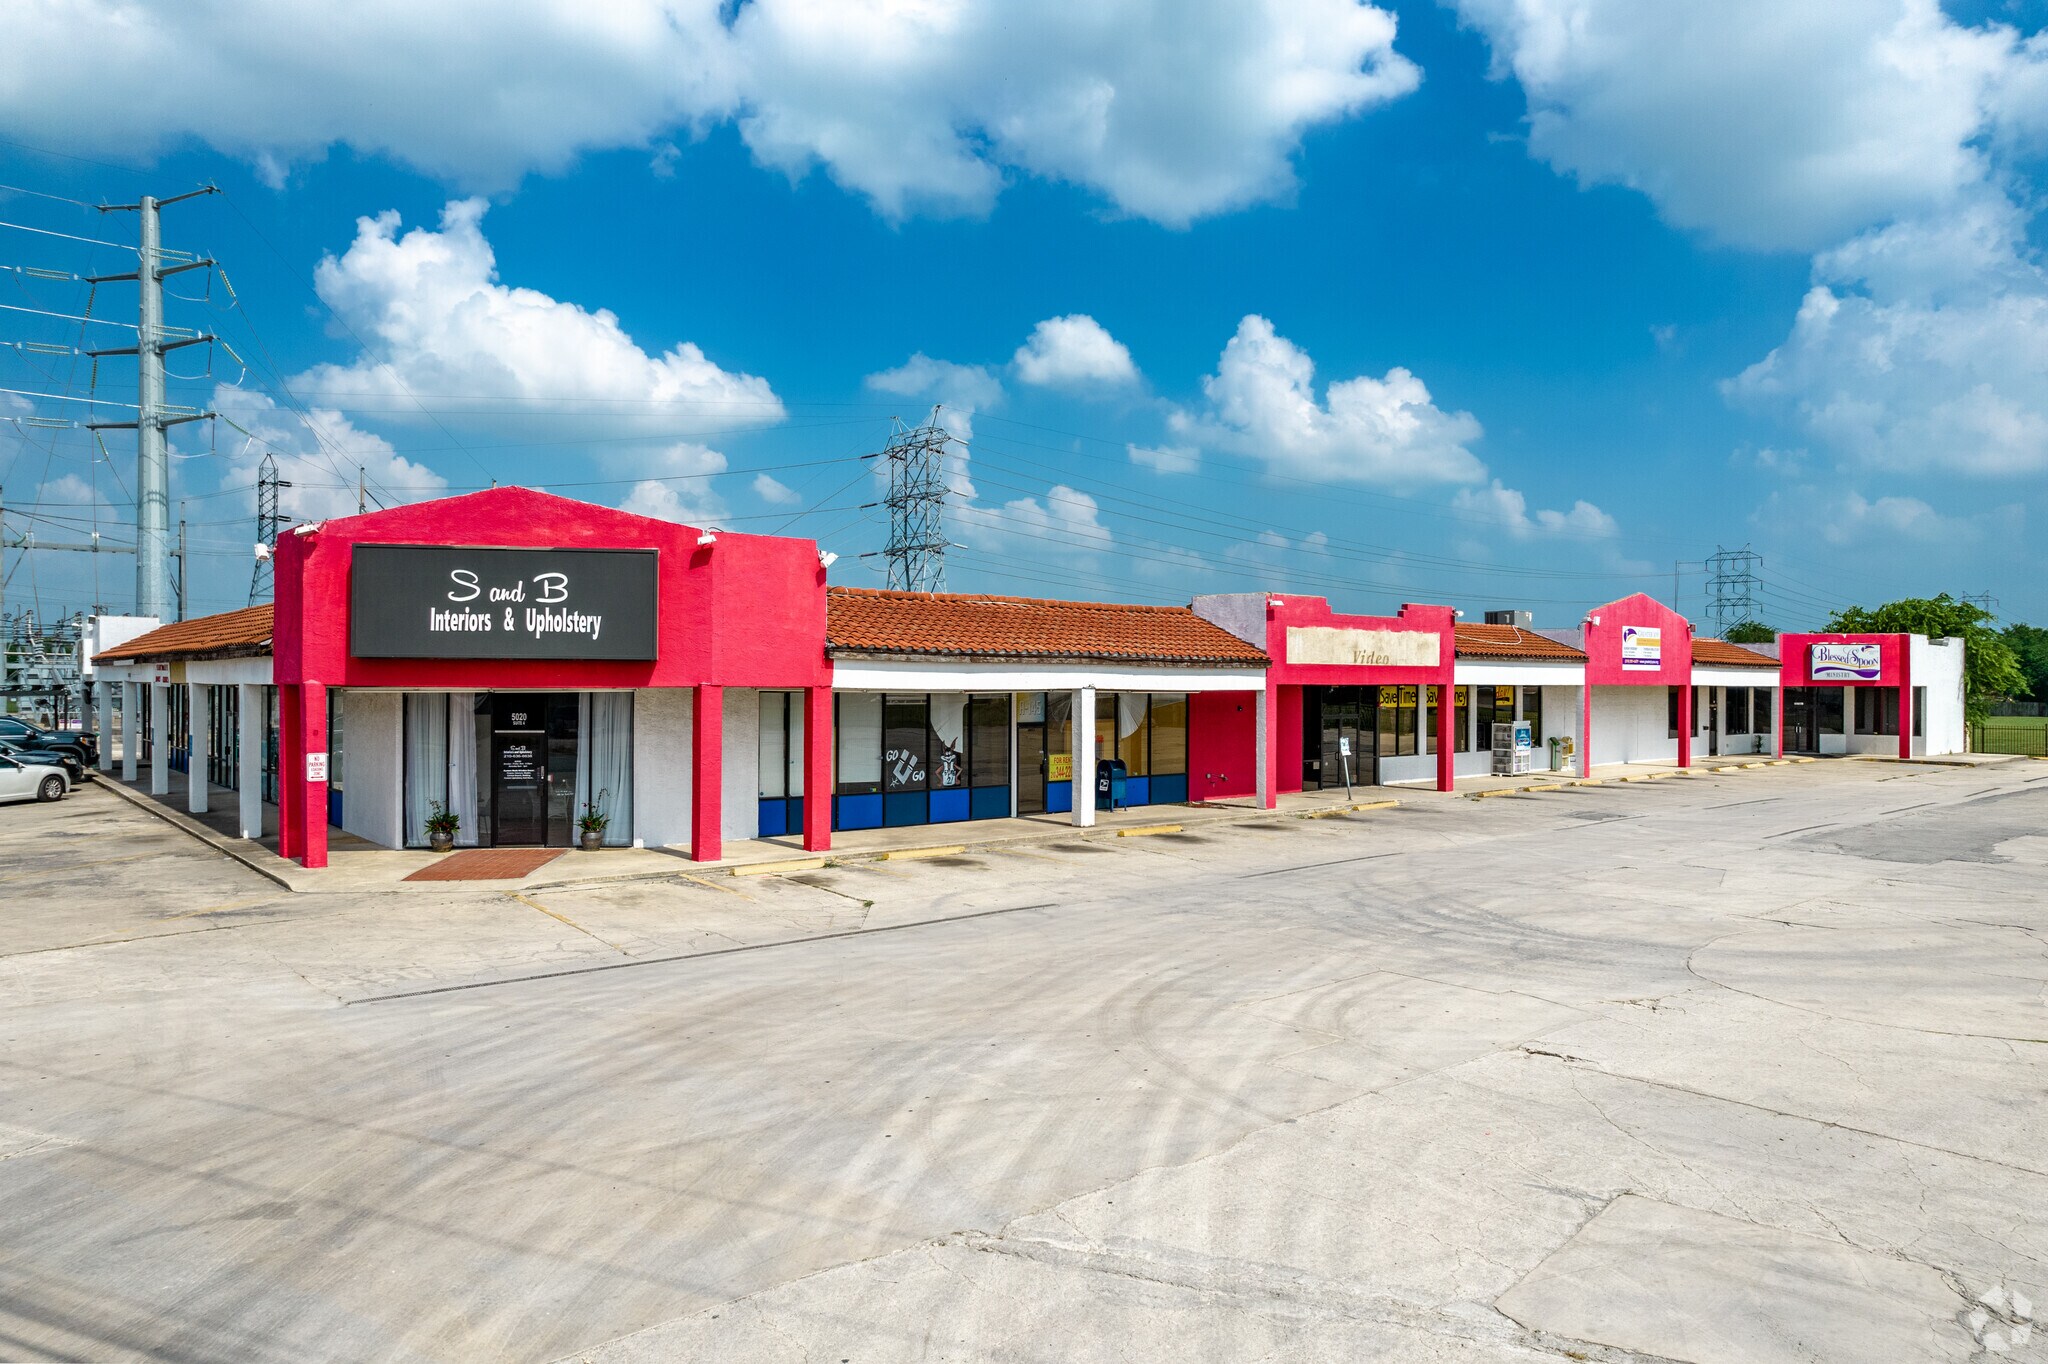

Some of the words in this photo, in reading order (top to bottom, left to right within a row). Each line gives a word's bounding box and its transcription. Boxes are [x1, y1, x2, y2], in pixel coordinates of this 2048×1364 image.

[447, 569, 481, 602] S
[489, 580, 526, 603] and
[533, 572, 569, 603] B
[430, 606, 492, 632] Interiors
[503, 607, 515, 632] &
[526, 607, 602, 640] Upholstery
[1353, 650, 1390, 665] Video
[1812, 645, 1849, 664] Blessed
[1380, 688, 1397, 703] Save
[1399, 687, 1416, 703] Time
[1427, 688, 1438, 703] Sav
[886, 749, 899, 762] GO
[1053, 756, 1062, 764] FOR
[912, 770, 925, 782] GO
